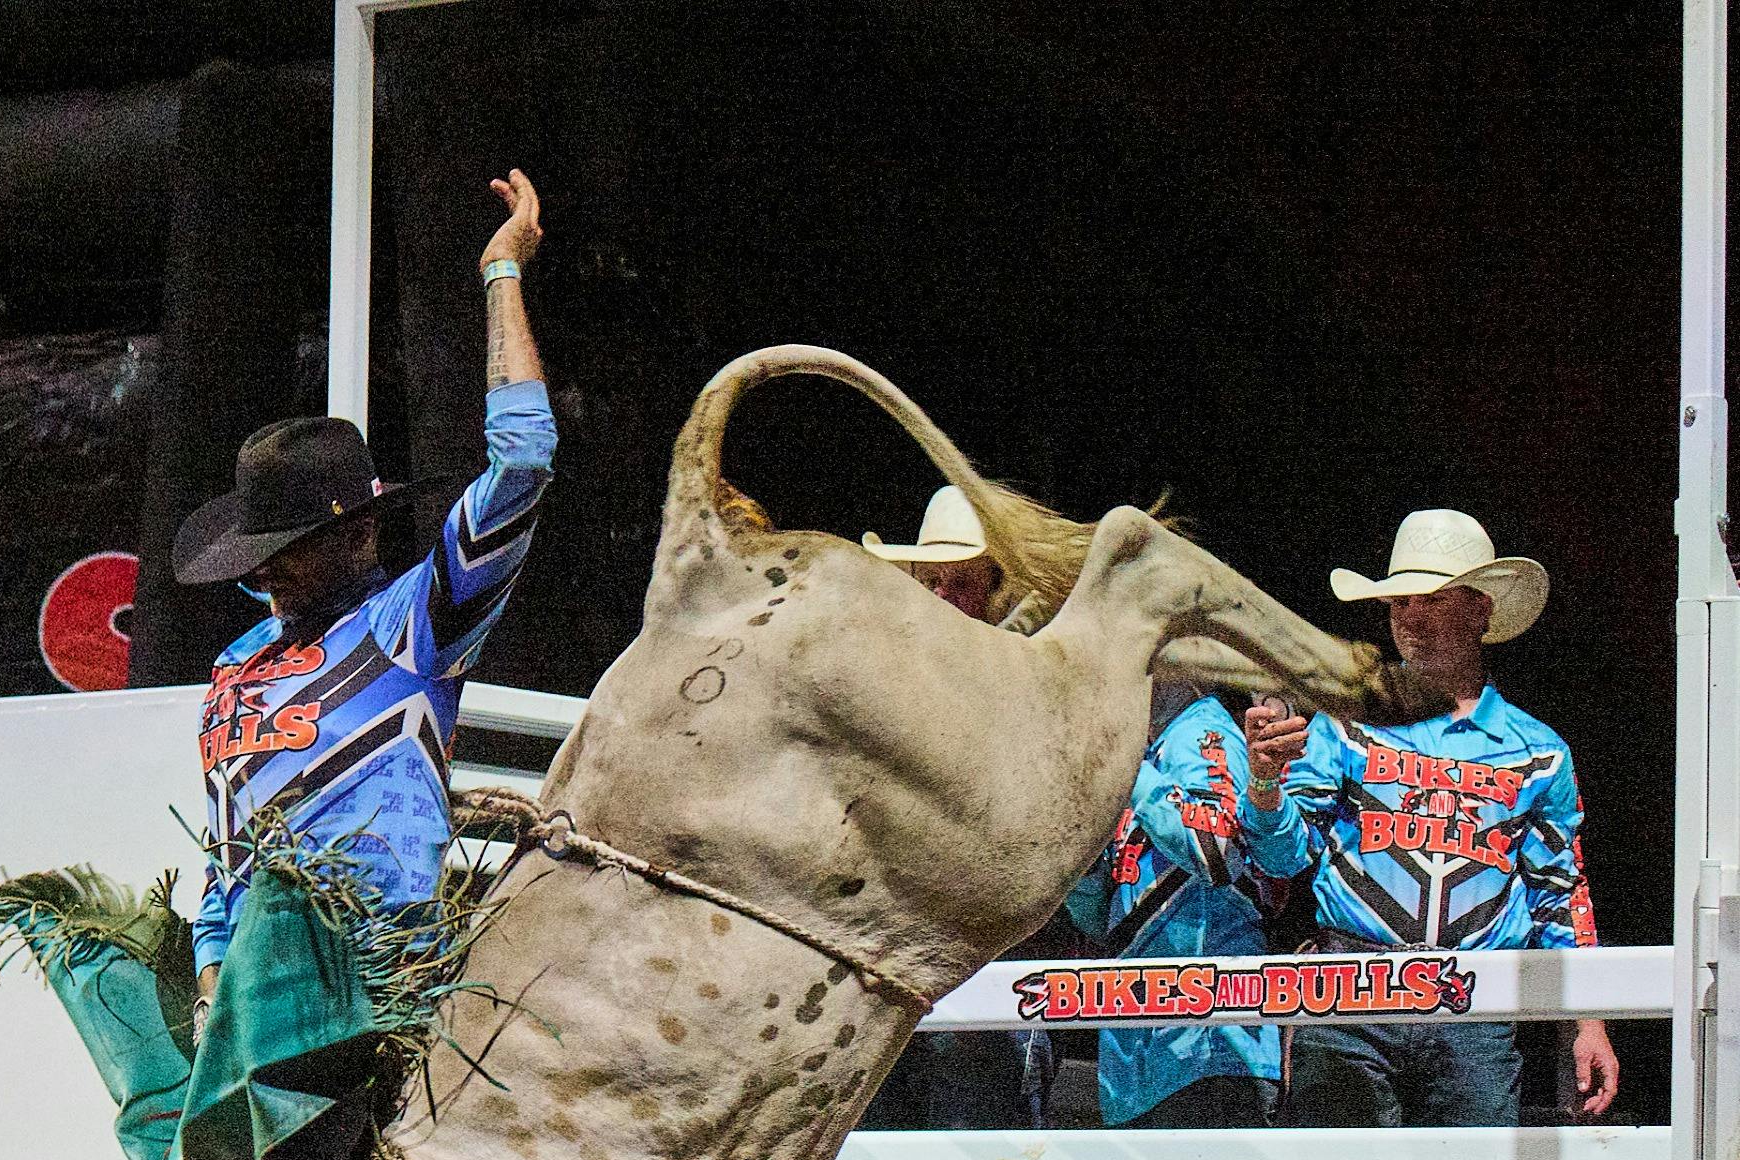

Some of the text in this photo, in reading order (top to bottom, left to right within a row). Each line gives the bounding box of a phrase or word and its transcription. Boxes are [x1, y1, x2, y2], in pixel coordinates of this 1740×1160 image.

[199, 701, 321, 773] ULLS
[1363, 743, 1524, 809] BIKES
[1428, 793, 1456, 816] AND
[1360, 811, 1512, 873] BULLS
[1044, 960, 1444, 1018] BIKES AND BULLS
